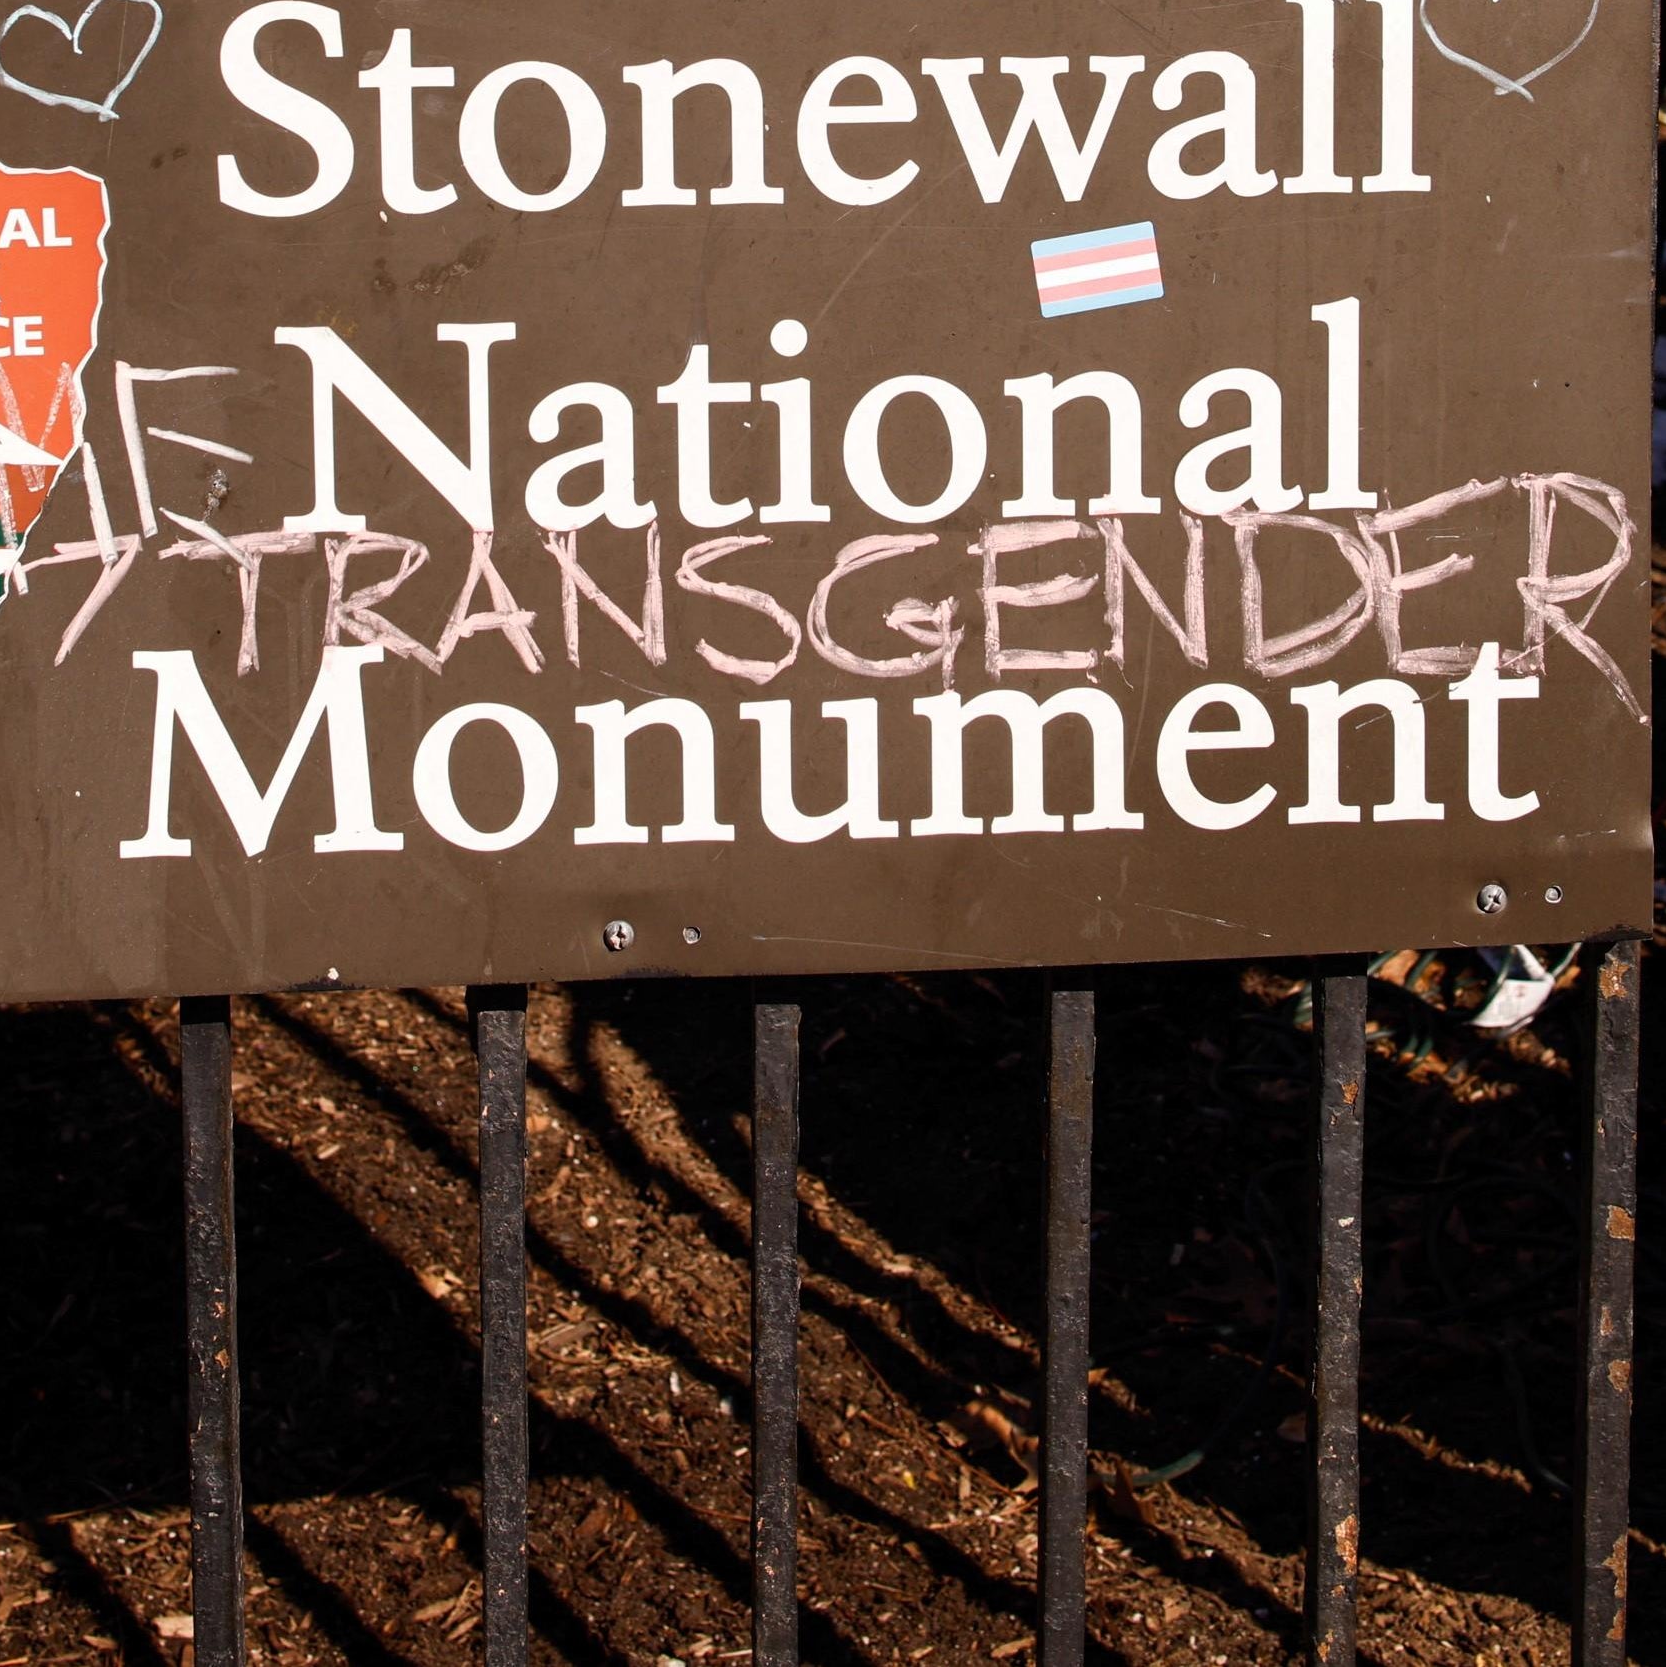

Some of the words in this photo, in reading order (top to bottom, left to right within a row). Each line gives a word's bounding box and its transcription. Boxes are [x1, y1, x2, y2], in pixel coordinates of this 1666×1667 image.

[274, 296, 1378, 534] National
[158, 472, 1651, 727] TRANSGENDER
[119, 641, 1540, 858] Monument
